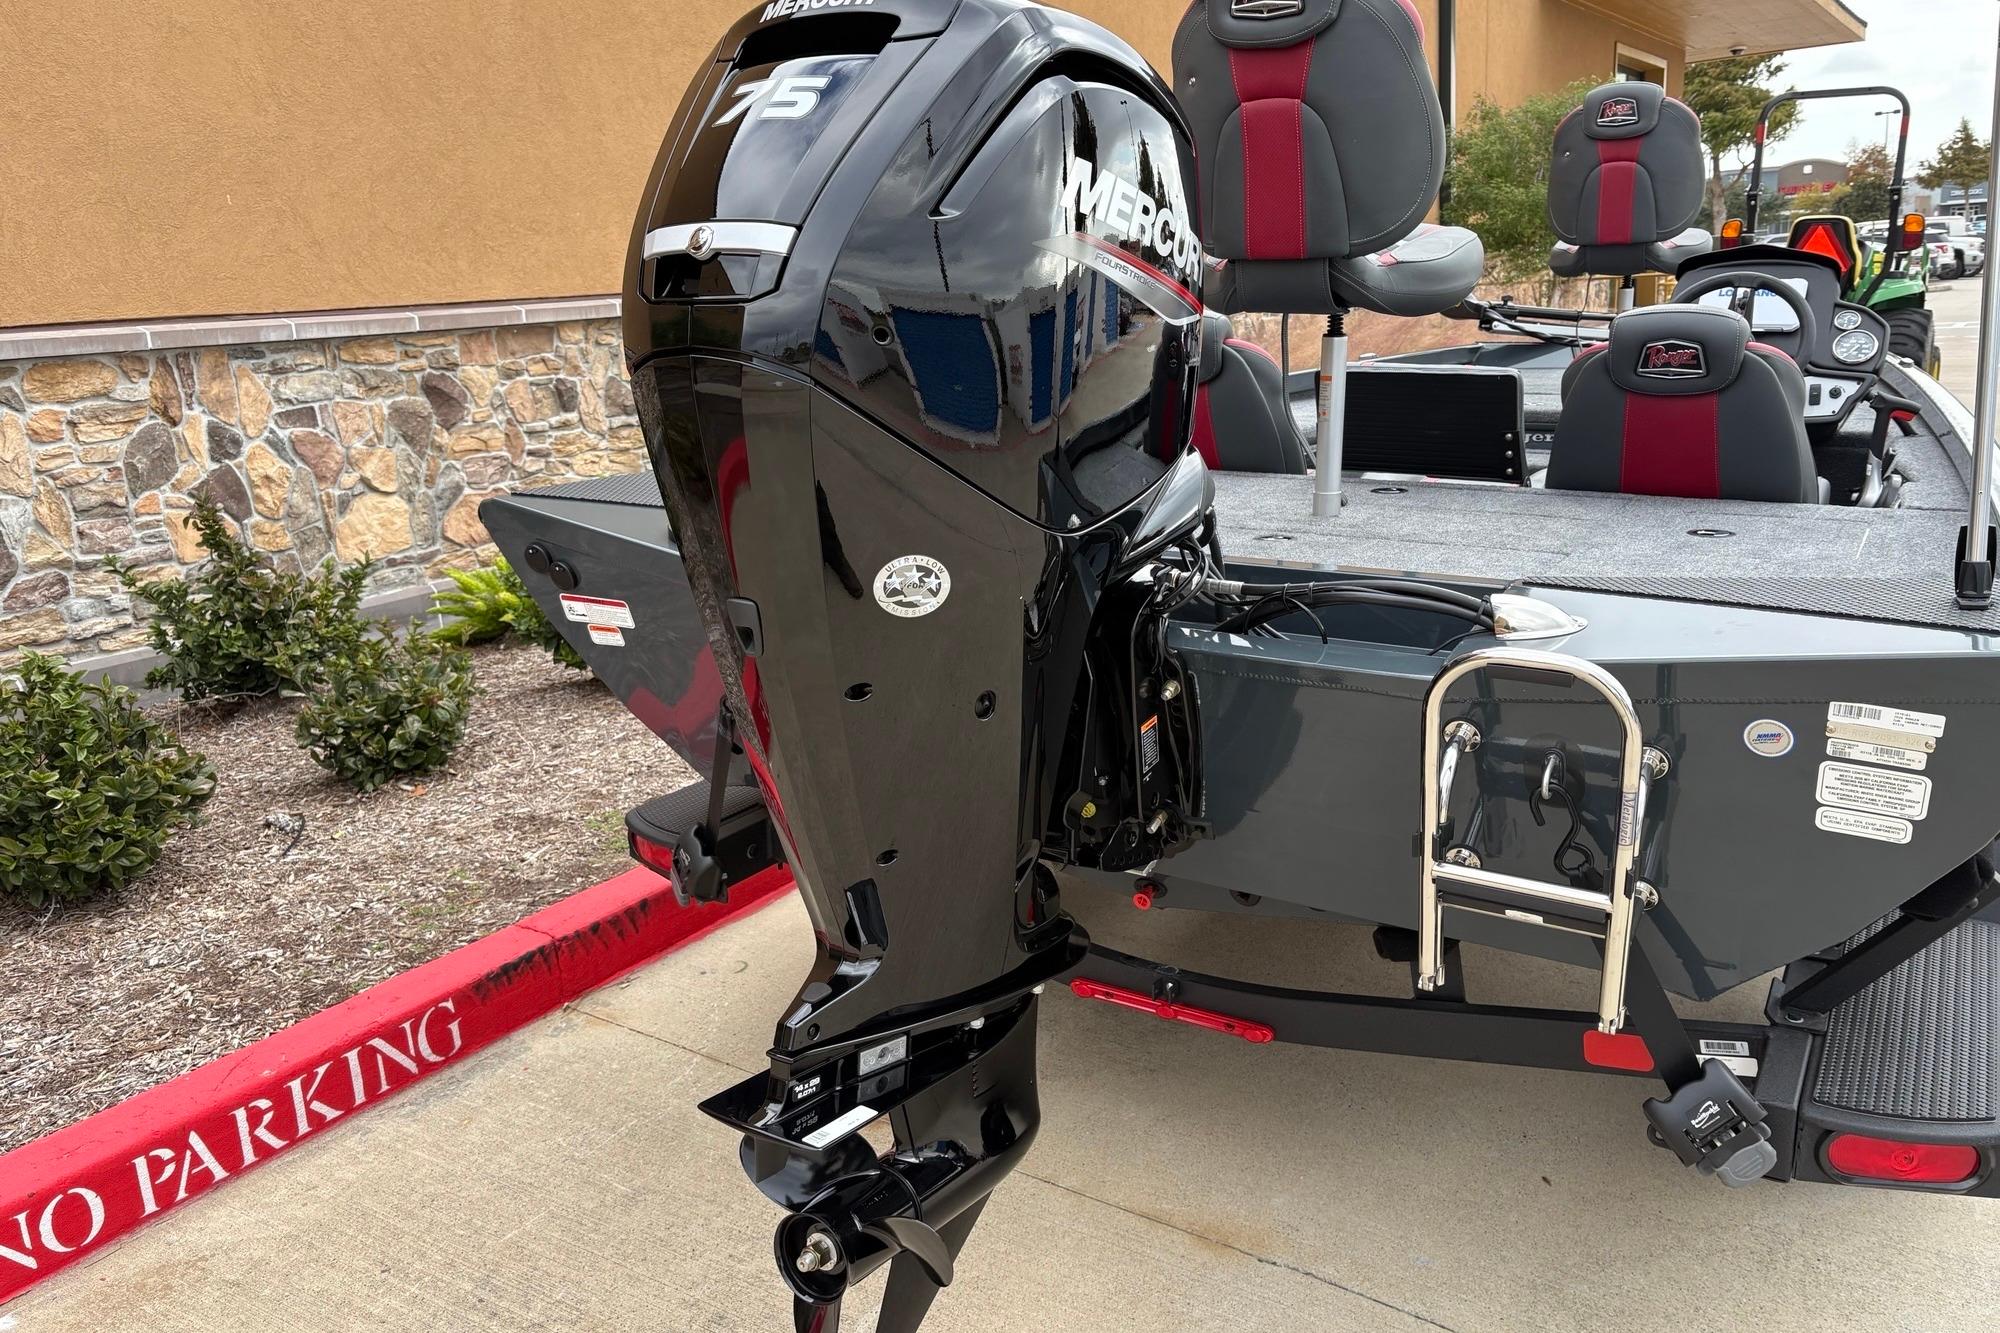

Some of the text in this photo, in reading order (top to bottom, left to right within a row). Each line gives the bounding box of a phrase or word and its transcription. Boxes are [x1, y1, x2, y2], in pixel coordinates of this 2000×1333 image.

[712, 75, 832, 127] 75
[1060, 157, 1203, 288] MERCUR
[1647, 345, 1698, 368] Ranger
[885, 557, 946, 574] ULTRA LOW
[1619, 794, 1636, 844] Metalogic
[132, 997, 464, 1218] PARKING
